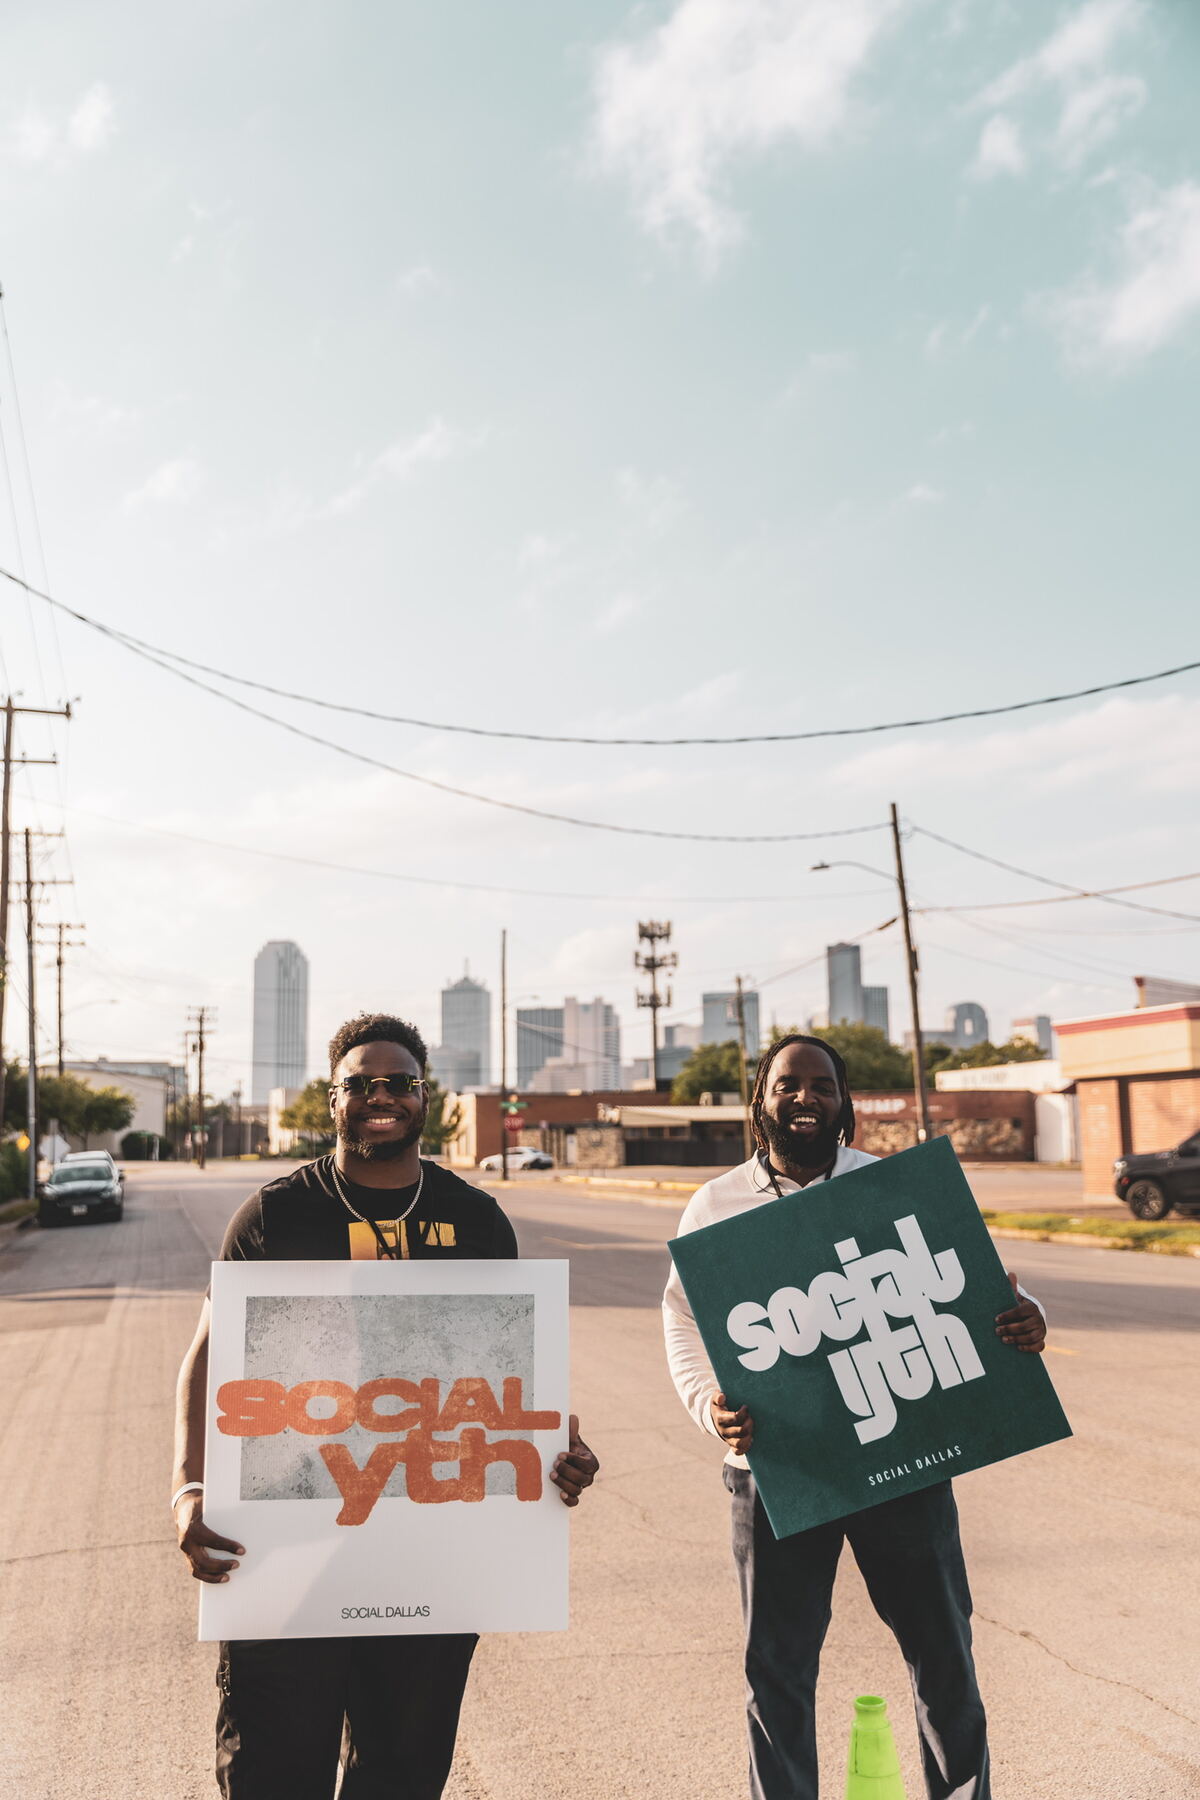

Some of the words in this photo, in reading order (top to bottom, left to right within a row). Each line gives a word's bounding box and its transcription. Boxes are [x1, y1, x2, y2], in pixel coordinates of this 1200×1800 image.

[726, 1214, 965, 1372] social
[216, 1377, 561, 1436] SOCIAL
[318, 1428, 542, 1527] yth
[868, 1464, 911, 1486] SOCIAL
[916, 1445, 962, 1469] DALLAS
[341, 1607, 384, 1619] SOCIAL
[385, 1605, 430, 1618] DALLAS
